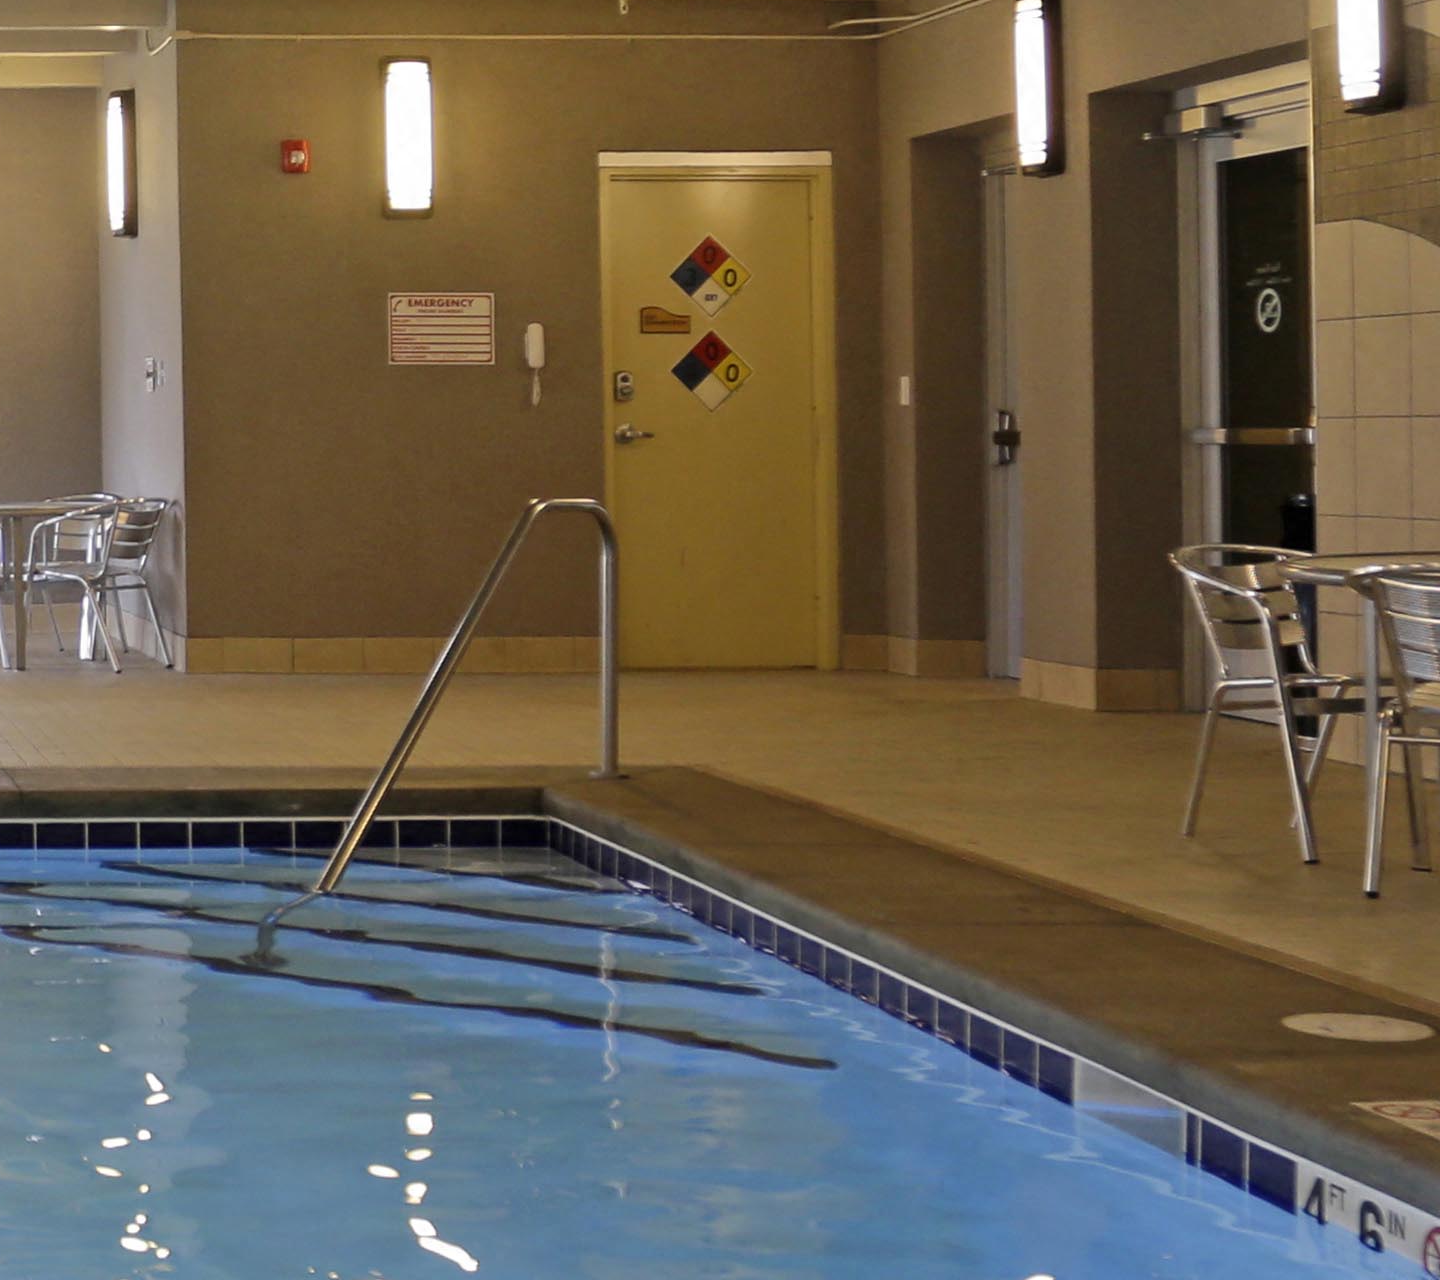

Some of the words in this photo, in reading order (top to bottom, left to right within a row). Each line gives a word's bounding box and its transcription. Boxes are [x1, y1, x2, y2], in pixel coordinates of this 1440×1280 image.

[703, 246, 716, 264] 0
[724, 269, 737, 287] 0
[408, 299, 475, 308] EMERGENCY
[705, 342, 719, 361] 0
[726, 364, 740, 382] 0
[1304, 1177, 1327, 1225] 4
[1329, 1183, 1346, 1211] FT
[1360, 1200, 1384, 1253] 6
[1388, 1209, 1406, 1240] IN
